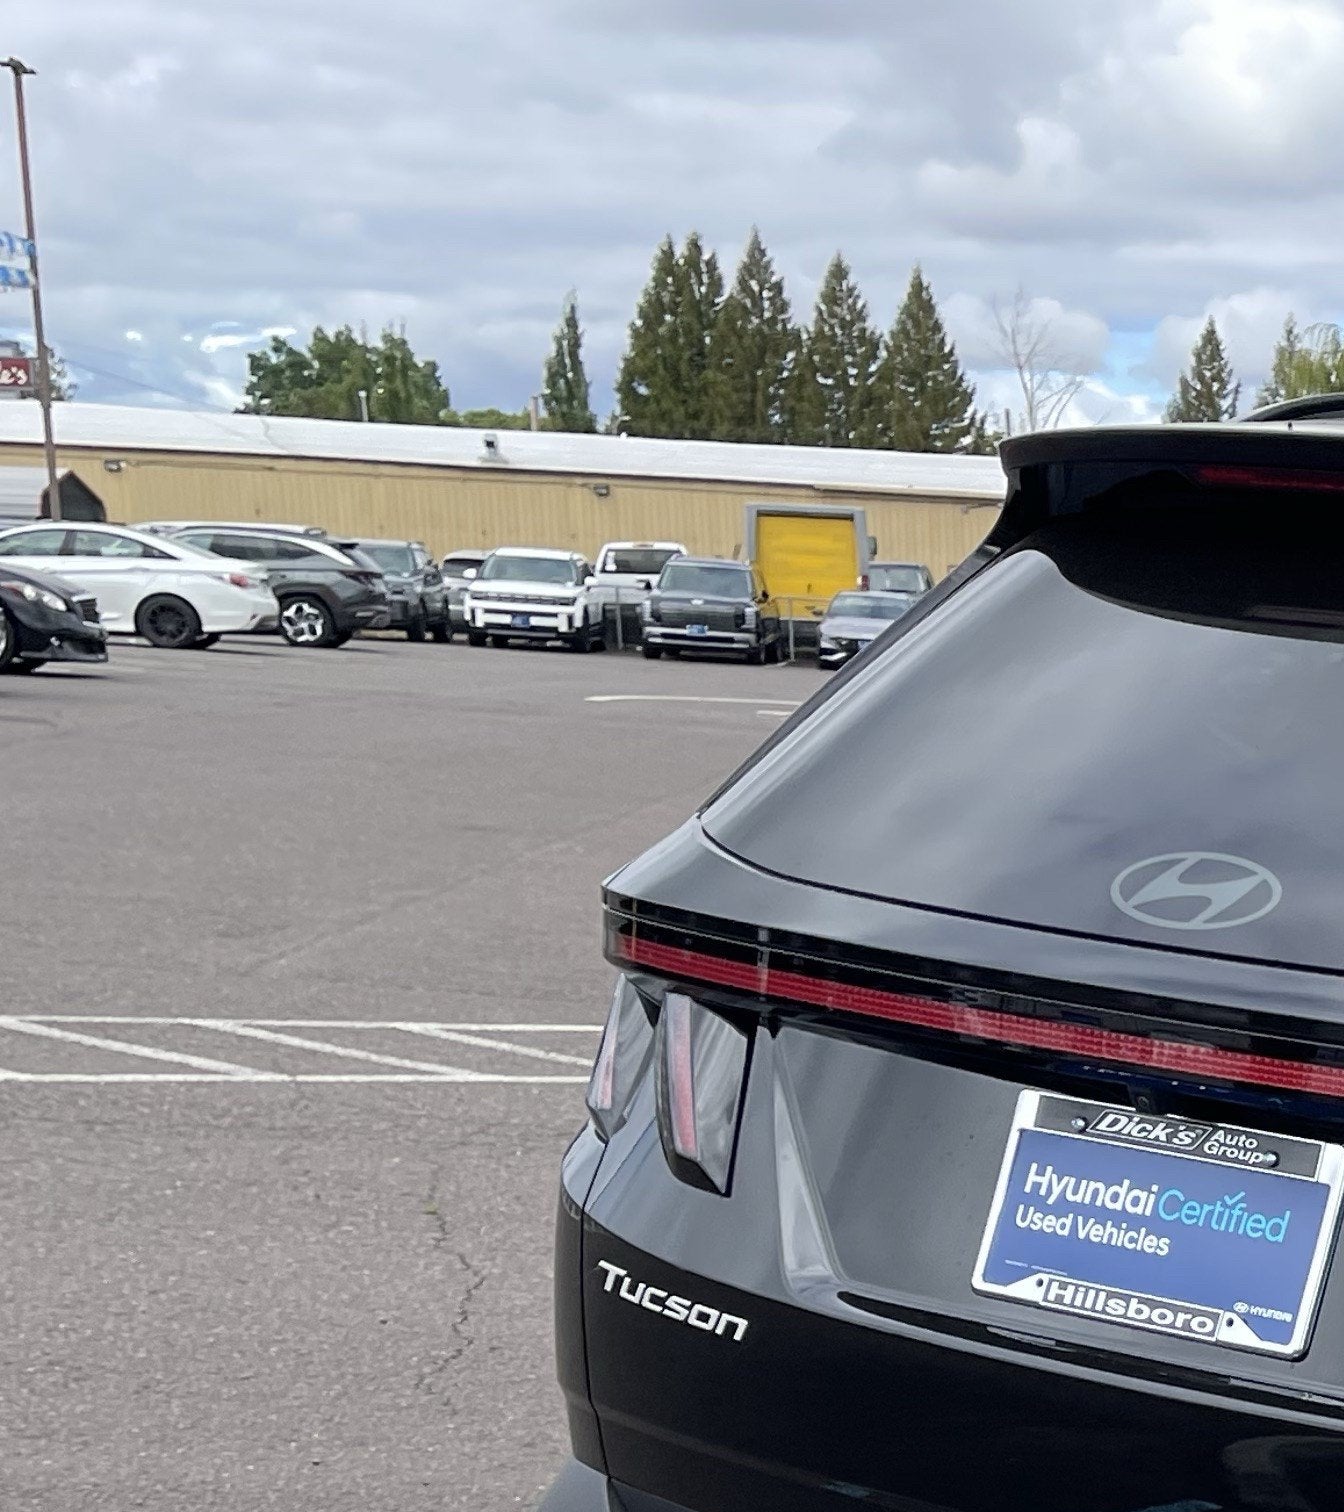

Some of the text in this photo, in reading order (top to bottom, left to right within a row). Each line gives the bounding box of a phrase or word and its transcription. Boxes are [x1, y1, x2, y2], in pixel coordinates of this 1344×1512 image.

[1096, 1113, 1197, 1146] Dick's
[1210, 1129, 1259, 1149] Auto
[1203, 1140, 1265, 1165] Group
[1024, 1162, 1291, 1244] Hyundai Certified
[1015, 1204, 1171, 1257] Used Vehicles
[1046, 1281, 1216, 1335] Hillsboro
[1249, 1304, 1294, 1323] HYUNDAI
